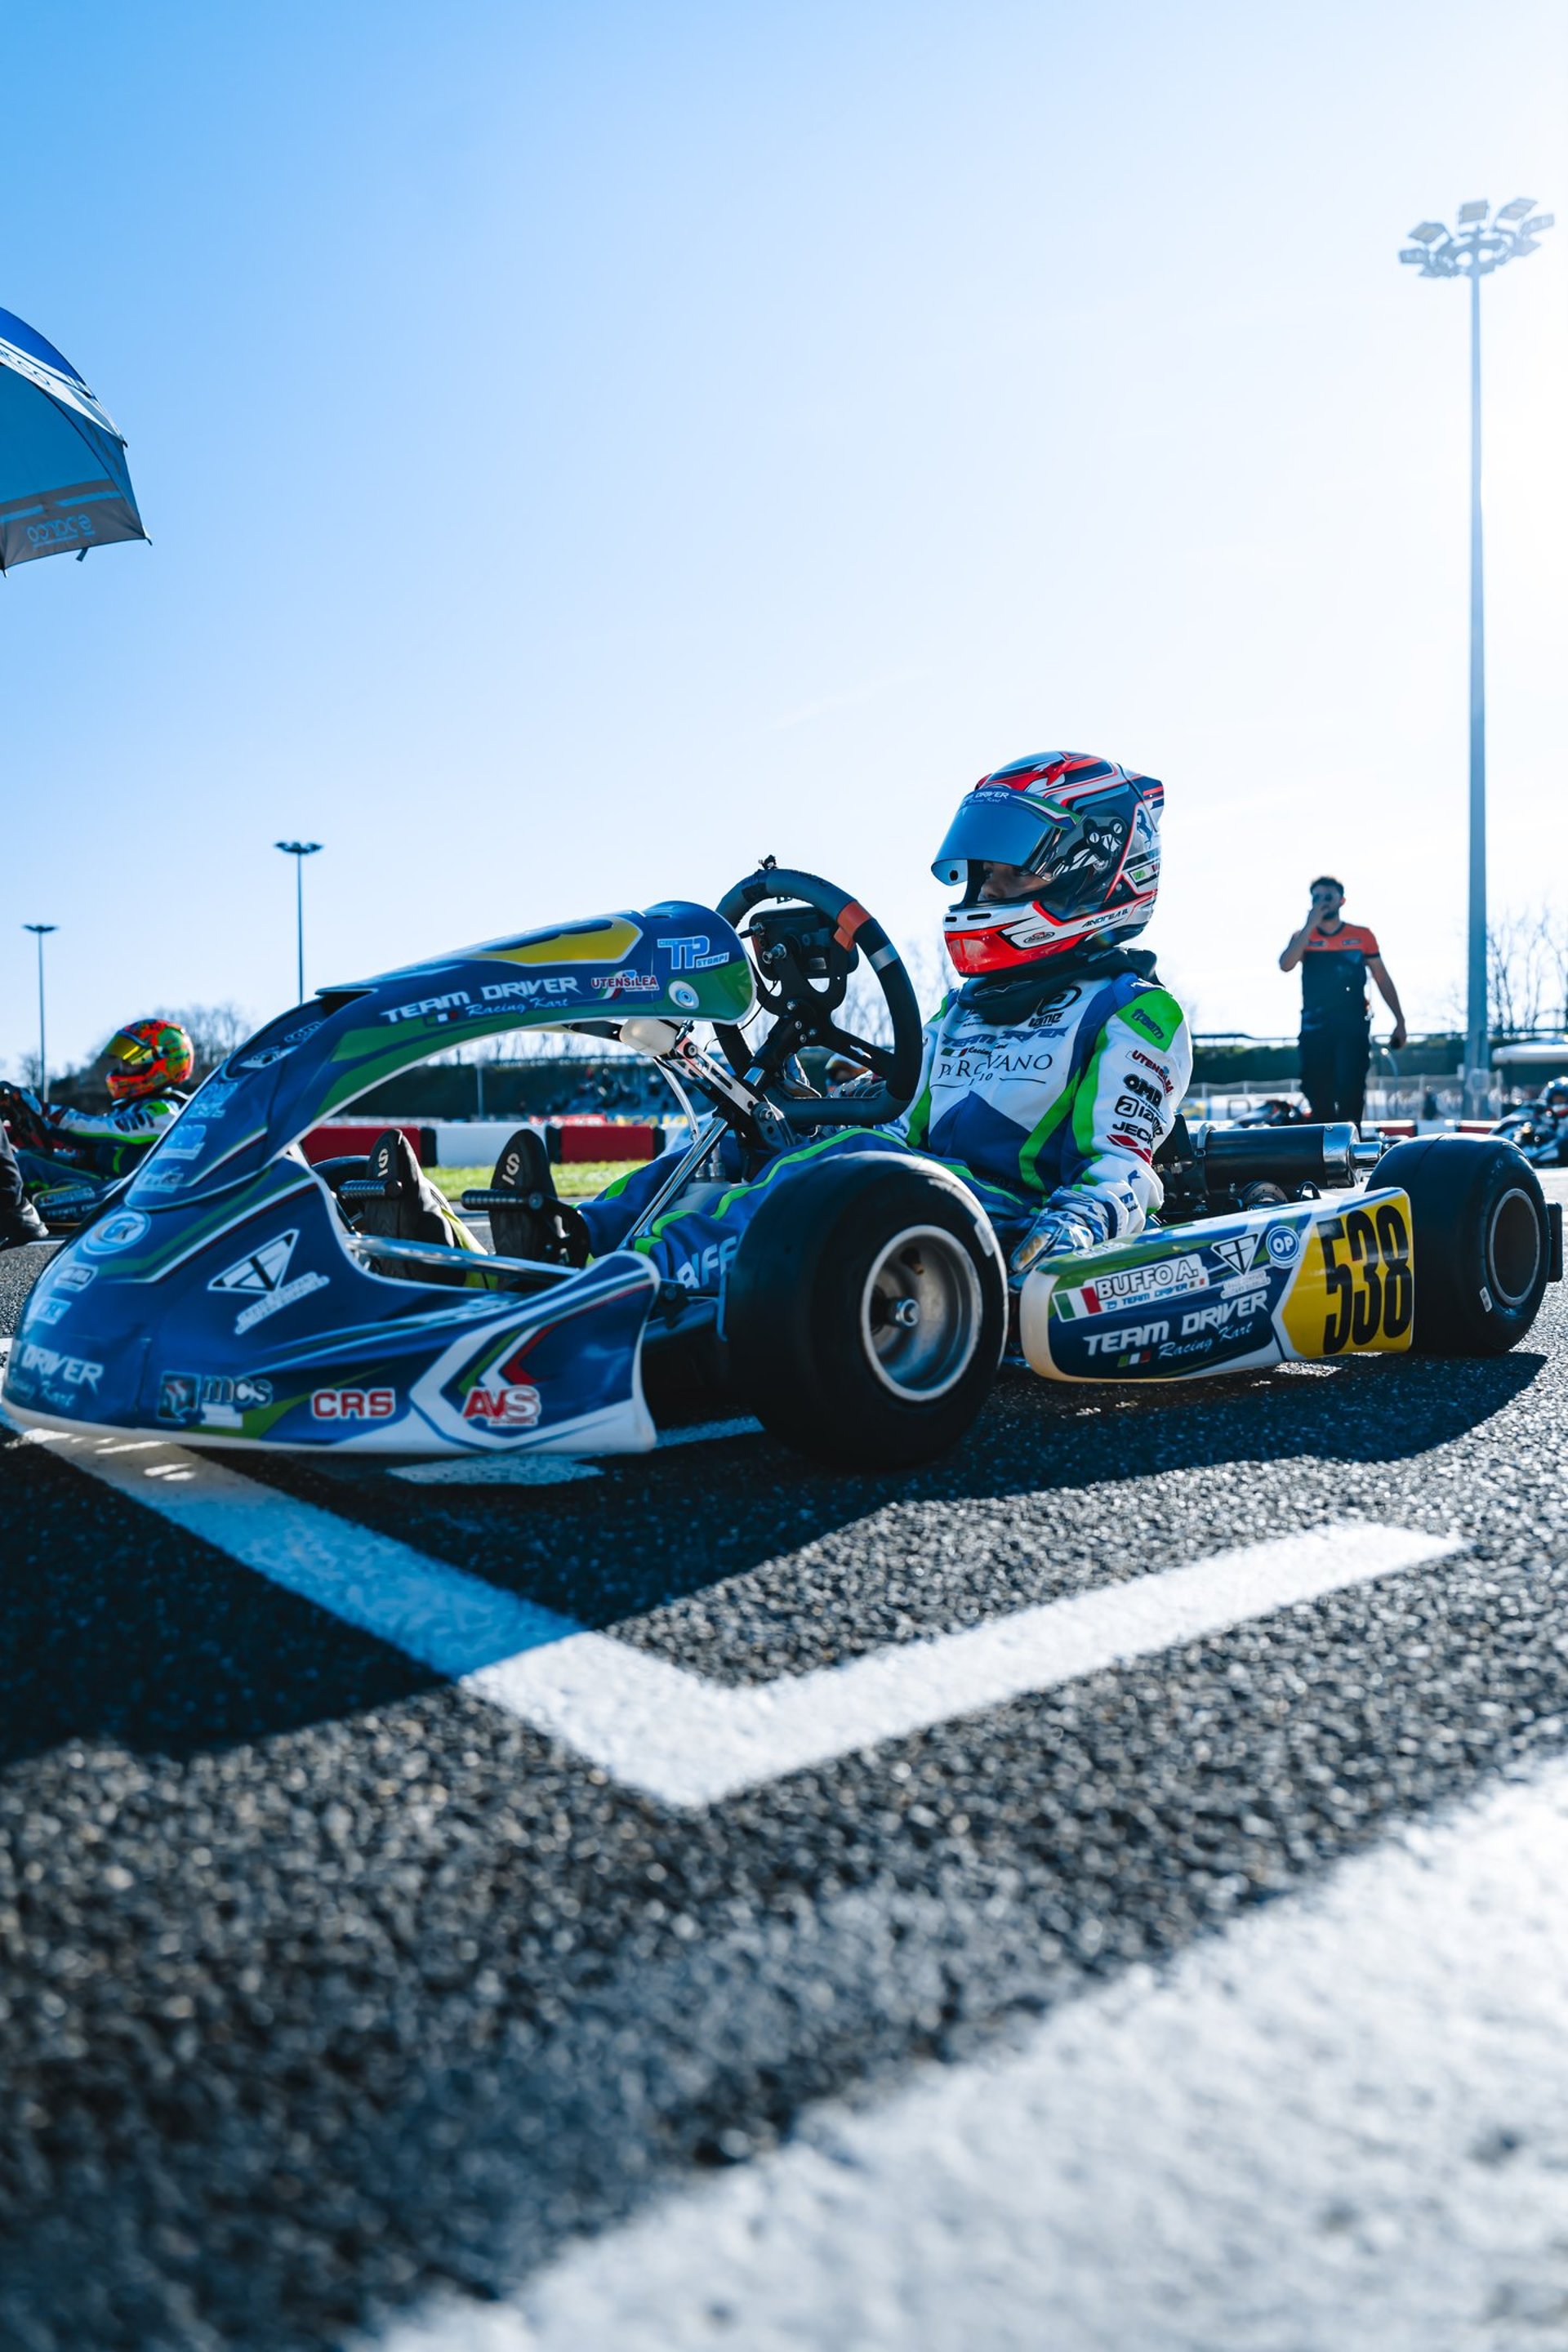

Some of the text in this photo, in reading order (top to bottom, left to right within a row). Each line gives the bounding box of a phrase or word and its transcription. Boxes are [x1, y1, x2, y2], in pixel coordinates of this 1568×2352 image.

[657, 935, 710, 970] TP
[591, 975, 657, 989] UTENSILEA
[380, 977, 583, 1023] TEAM DRIVER
[465, 996, 569, 1018] Racing Kart
[1272, 1236, 1294, 1254] OP
[1095, 1259, 1199, 1301] BUFFO A.
[1122, 1292, 1151, 1305] TEAM
[1153, 1282, 1188, 1298] DRIVER
[1315, 1205, 1414, 1356] 538
[1083, 1290, 1269, 1356] TEAM DRIVER
[1157, 1321, 1254, 1361] Racing Kart
[21, 1343, 105, 1396] DRIVER
[203, 1374, 274, 1410] mcs
[312, 1388, 394, 1418] CRS
[463, 1386, 540, 1419] AVS
